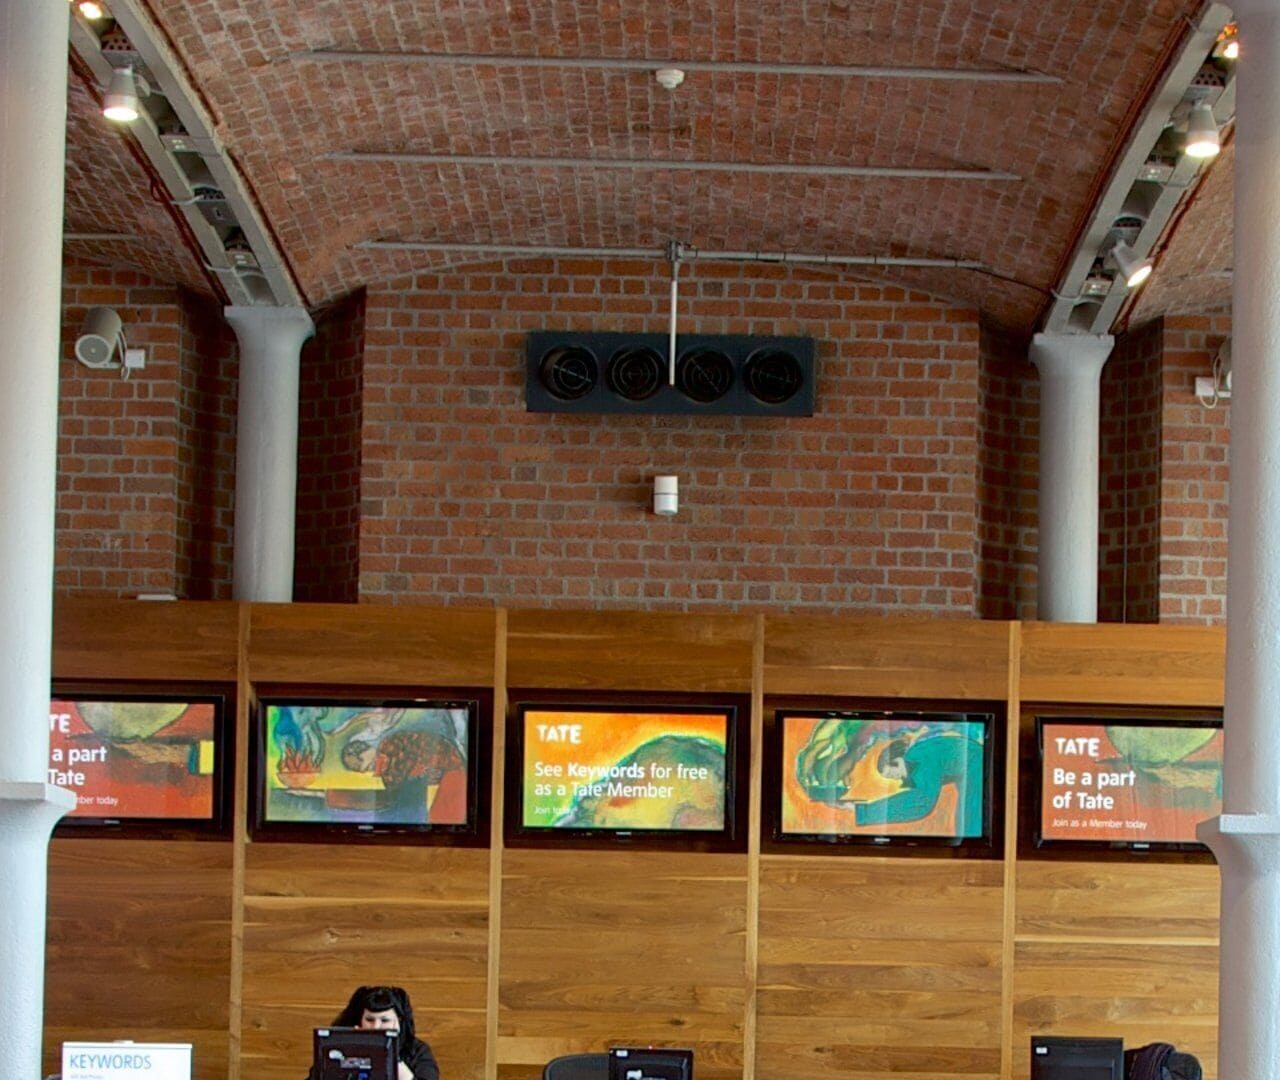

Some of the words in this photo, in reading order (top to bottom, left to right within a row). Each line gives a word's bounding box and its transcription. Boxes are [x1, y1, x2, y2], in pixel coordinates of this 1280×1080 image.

[49, 714, 71, 733] TE
[536, 724, 582, 745] TATE
[52, 748, 64, 762] a
[68, 746, 108, 766] part
[1055, 737, 1100, 757] TATE
[48, 769, 86, 786] Tate
[534, 762, 562, 778] See
[567, 763, 645, 780] Keywords
[650, 763, 673, 779] for
[677, 763, 708, 780] free
[1053, 768, 1076, 785] Be
[1081, 772, 1092, 785] a
[1097, 770, 1137, 789] part
[534, 784, 552, 797] as
[556, 784, 567, 797] a
[570, 782, 603, 798] Tate
[607, 783, 674, 799] Member
[1052, 791, 1073, 809] of
[1076, 792, 1115, 810] Tate
[1052, 817, 1069, 828] Join
[1089, 818, 1123, 829] Member
[1125, 820, 1148, 831] today
[70, 1053, 153, 1070] KEYWORDS
